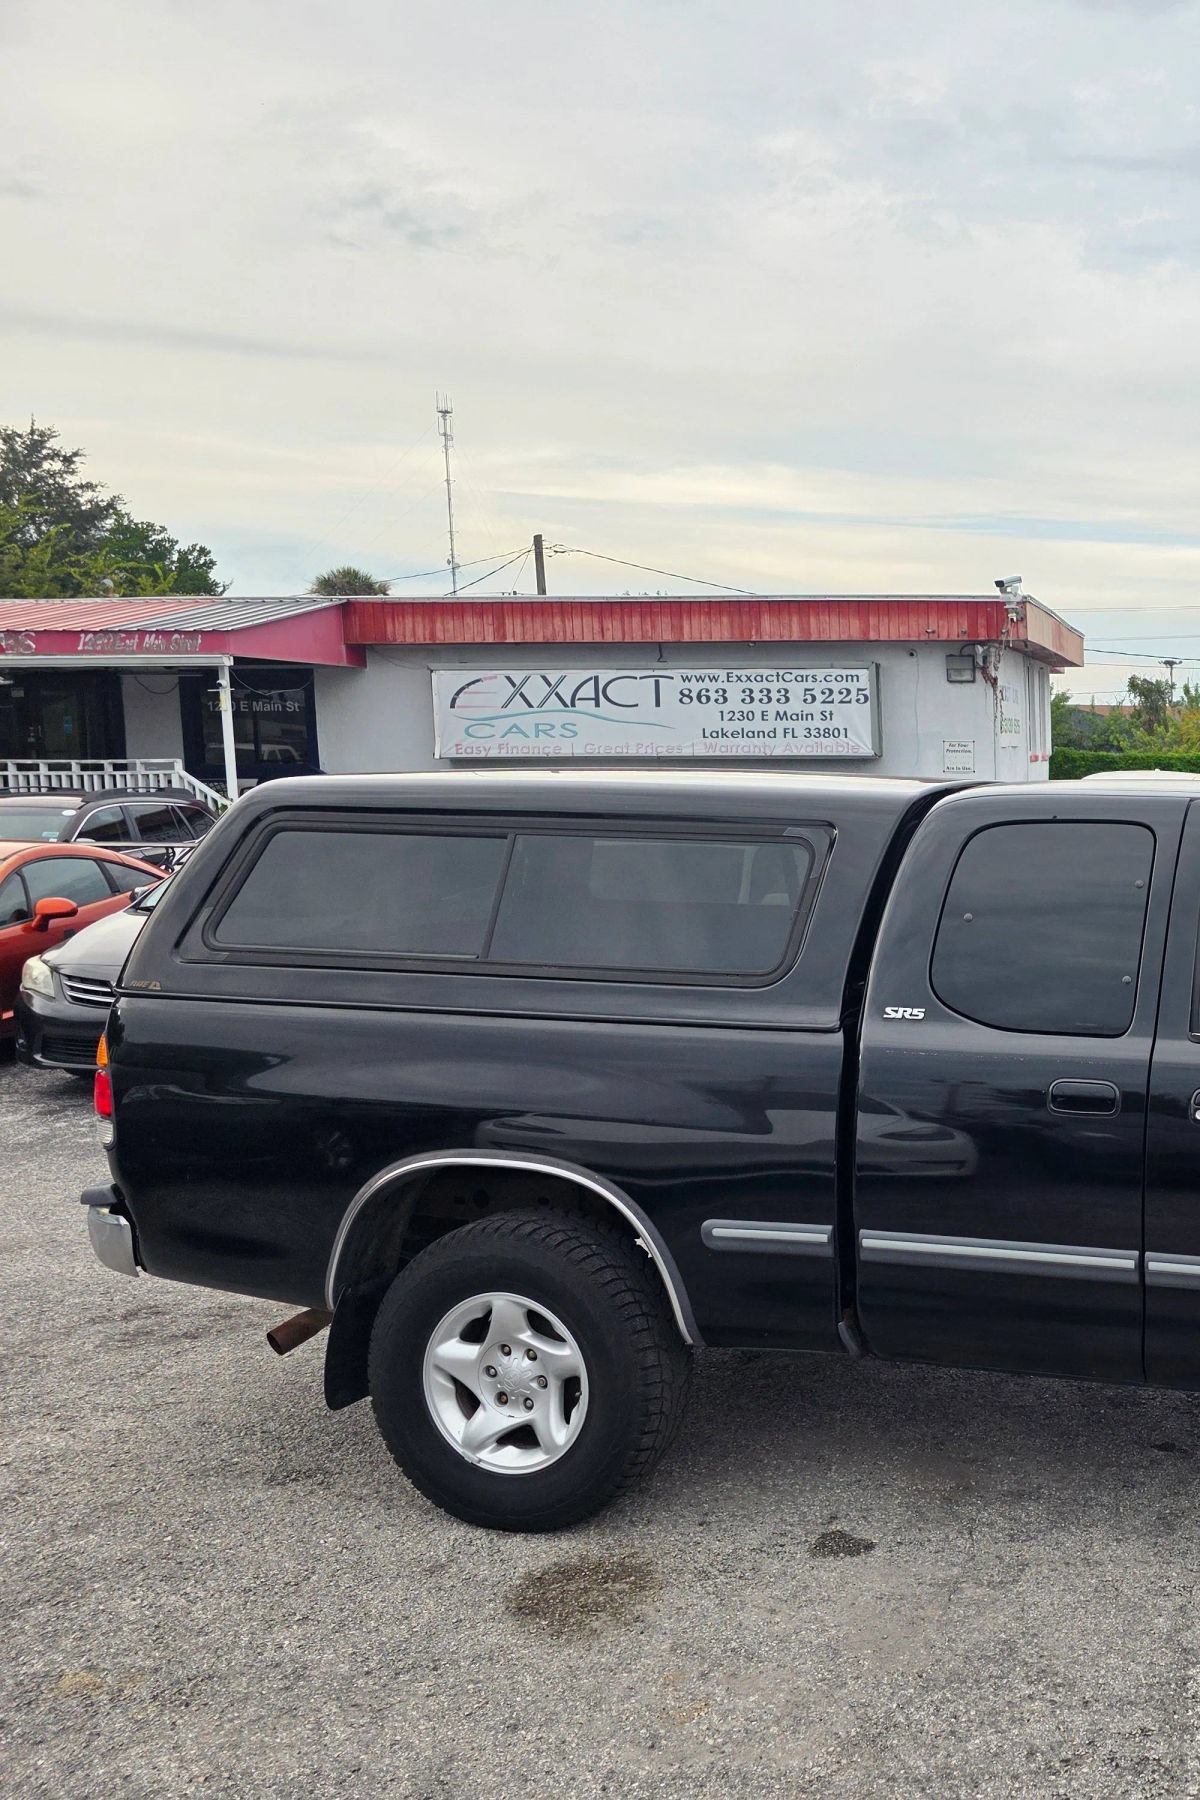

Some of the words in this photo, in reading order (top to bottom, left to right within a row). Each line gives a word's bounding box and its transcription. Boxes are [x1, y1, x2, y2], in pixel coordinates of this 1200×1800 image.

[681, 671, 860, 683] www.ExxactCars.com
[450, 674, 675, 709] EXXACT
[679, 688, 729, 705] 863
[741, 688, 790, 705] 333
[803, 688, 870, 705] 5225
[241, 701, 249, 712] E
[252, 701, 282, 712] Main
[286, 701, 300, 712] St
[719, 710, 755, 722] 1230
[761, 710, 769, 722] E
[775, 710, 814, 722] Main
[820, 710, 834, 722] St
[464, 723, 578, 739] CARS
[702, 728, 776, 739] Lakeland
[783, 728, 798, 739] FL
[804, 728, 848, 739] 33801
[455, 743, 491, 757] Easy
[498, 743, 563, 755] Finance
[584, 743, 630, 755] Great
[636, 743, 683, 756] Prices
[703, 742, 776, 756] Warranty
[780, 742, 861, 754] Available
[883, 1006, 926, 1020] SR5
